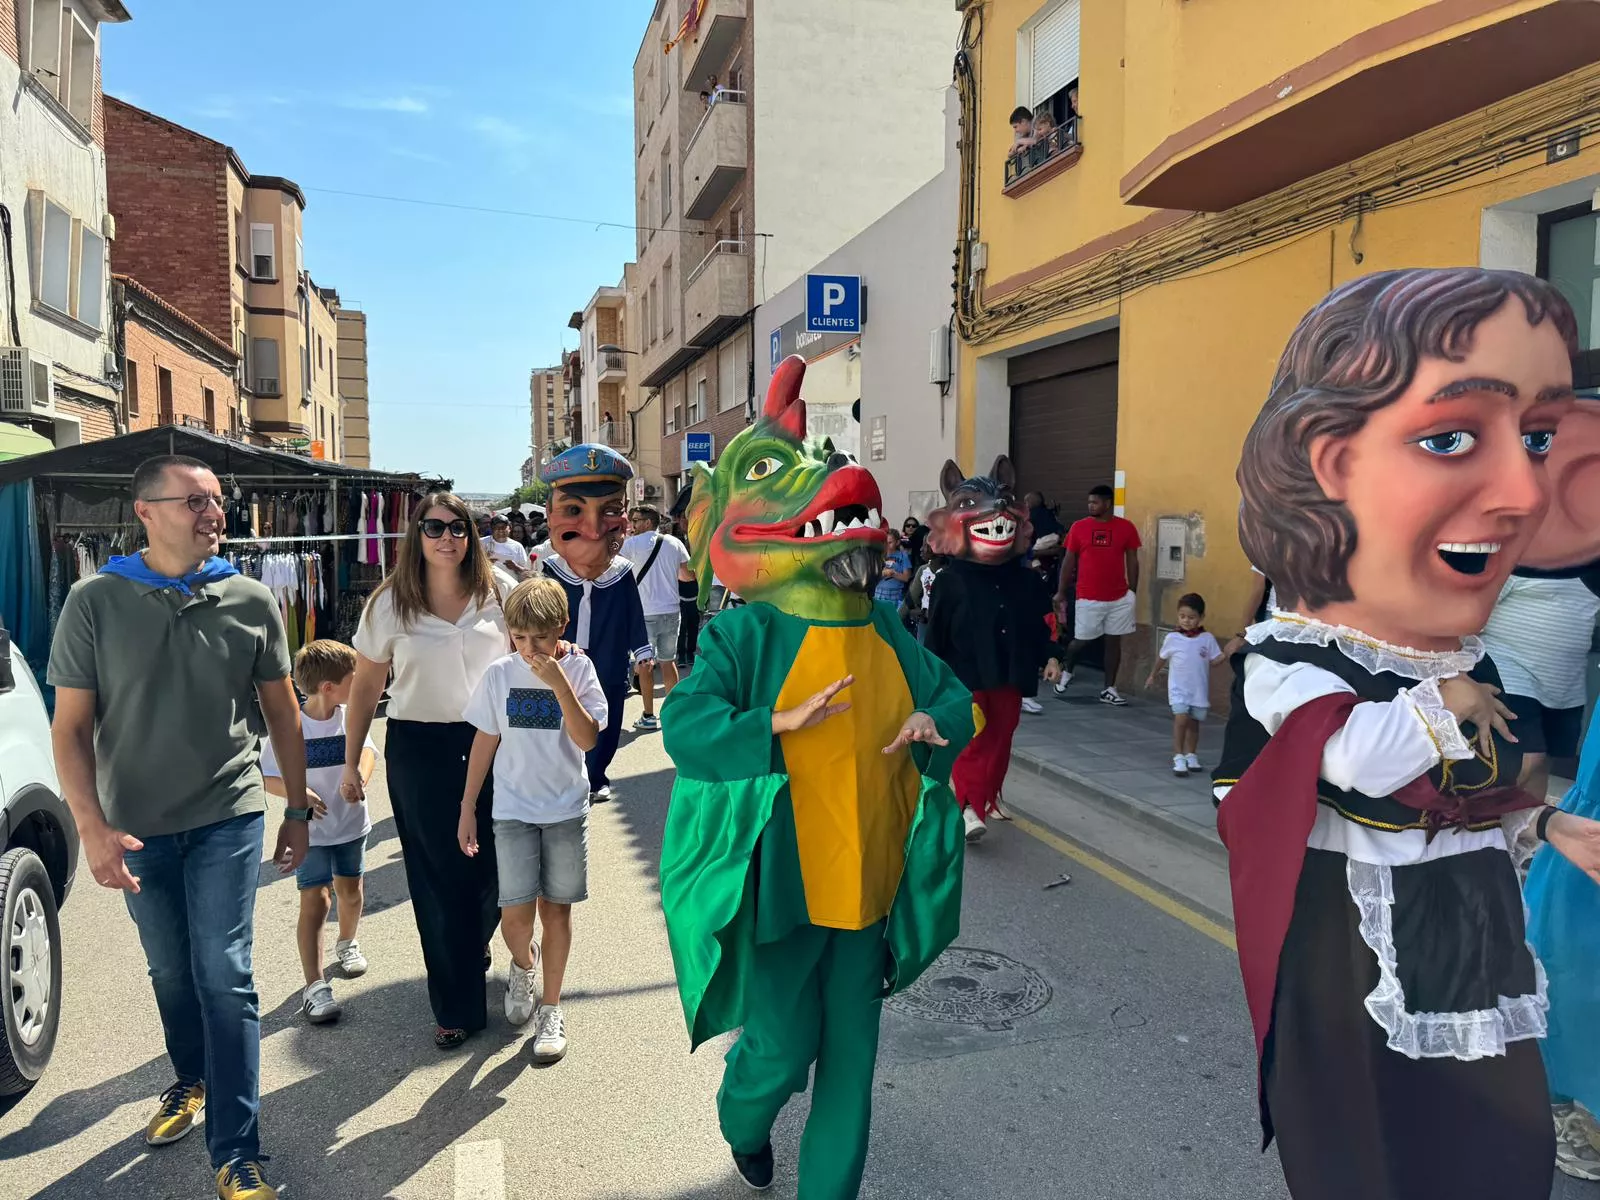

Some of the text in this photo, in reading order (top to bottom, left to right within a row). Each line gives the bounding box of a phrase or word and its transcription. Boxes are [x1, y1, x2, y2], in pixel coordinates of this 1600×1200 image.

[823, 282, 846, 316] P
[811, 317, 855, 327] CLIENTES
[772, 336, 779, 363] P
